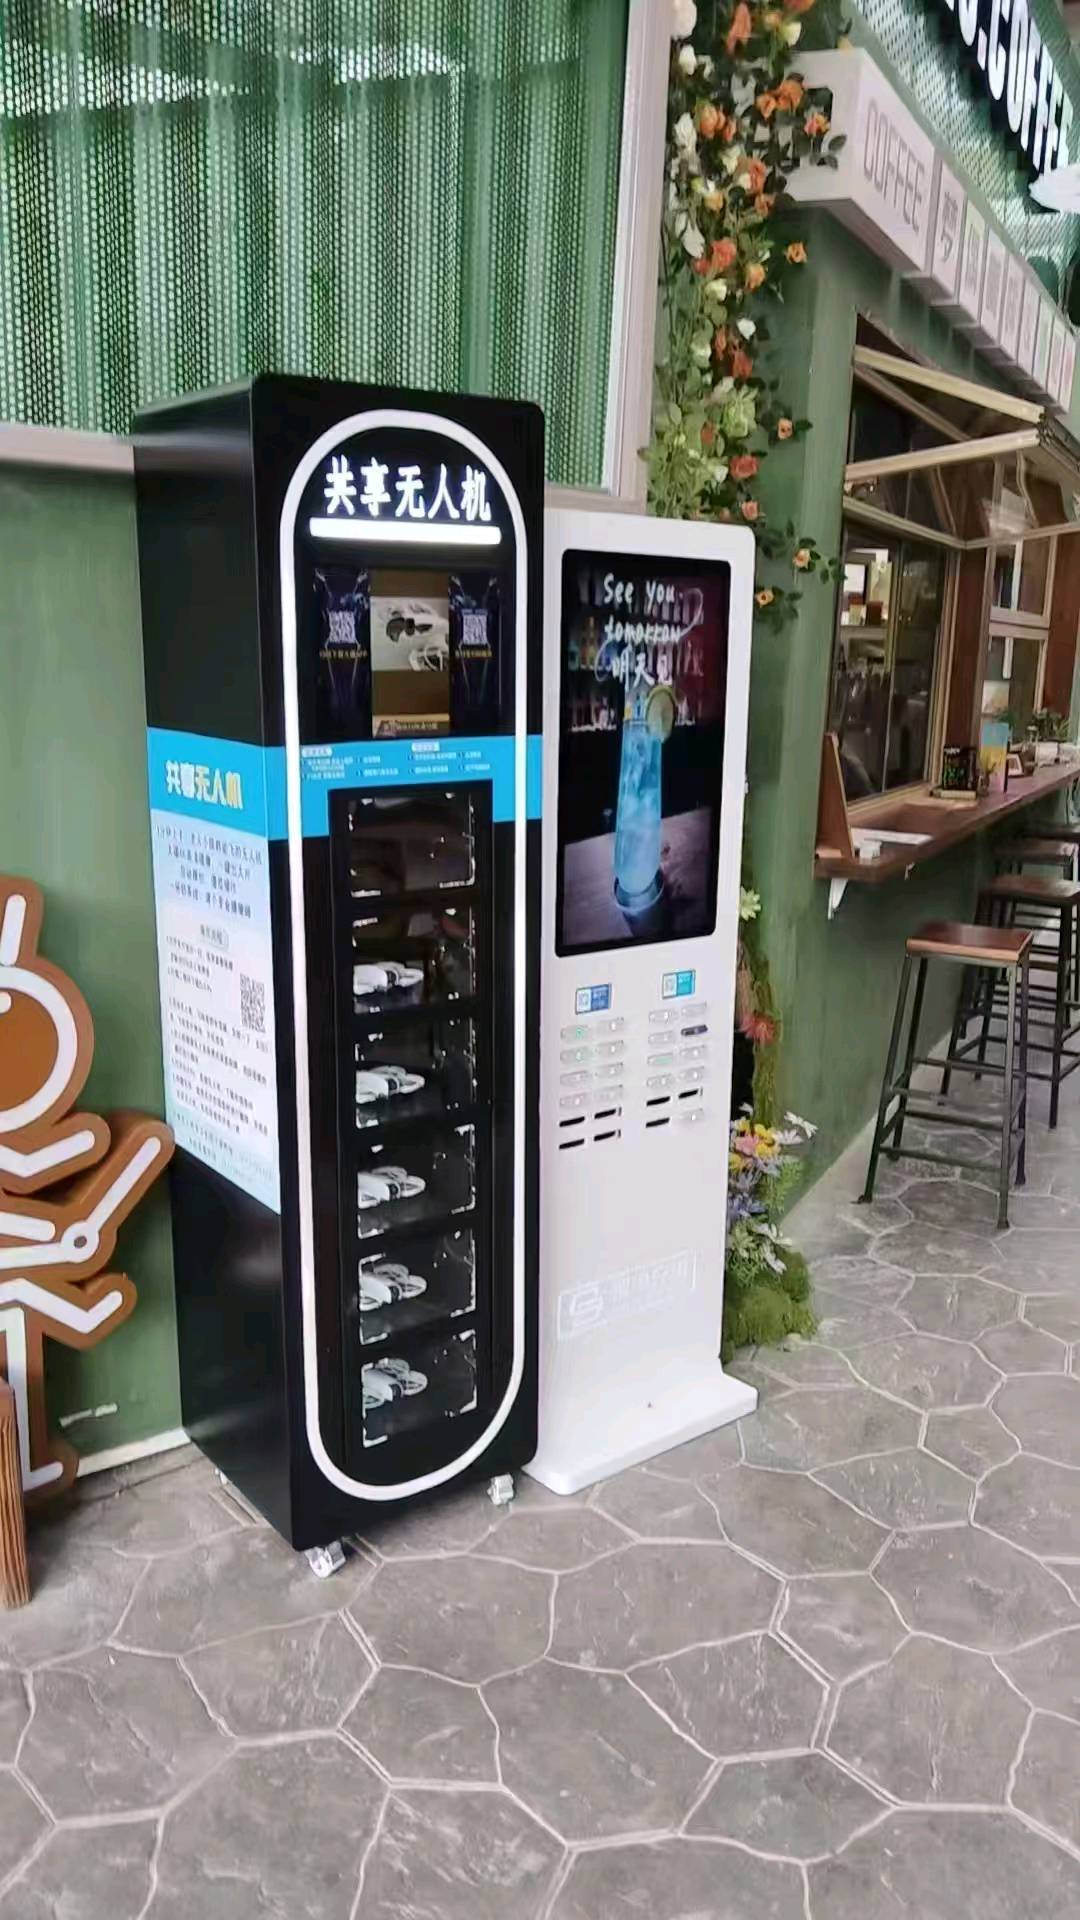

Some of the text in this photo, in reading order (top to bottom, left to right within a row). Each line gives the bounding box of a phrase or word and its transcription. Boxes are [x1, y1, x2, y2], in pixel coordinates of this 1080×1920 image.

[863, 102, 925, 234] COFFEE
[324, 454, 491, 521] 共享无人机
[604, 573, 675, 614] See you
